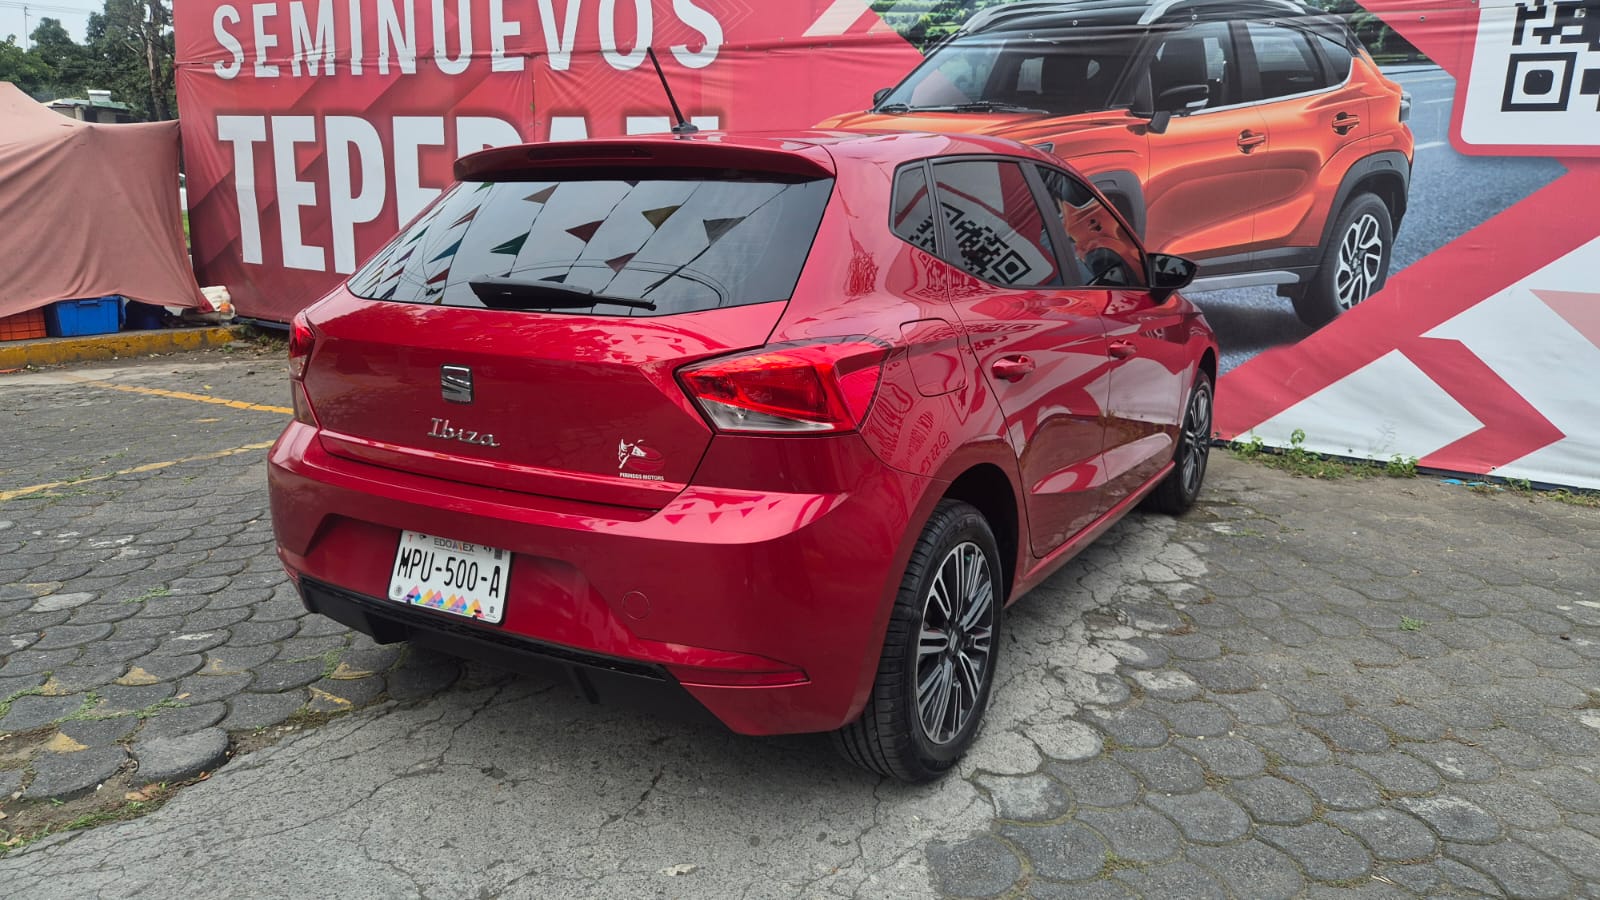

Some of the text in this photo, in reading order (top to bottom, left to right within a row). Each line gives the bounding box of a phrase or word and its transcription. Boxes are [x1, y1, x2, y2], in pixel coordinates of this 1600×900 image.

[213, 0, 724, 79] SEMINUEVOS
[216, 115, 719, 275] TEPE
[427, 417, 500, 448] Ibiza
[397, 547, 501, 599] MPU-500-A
